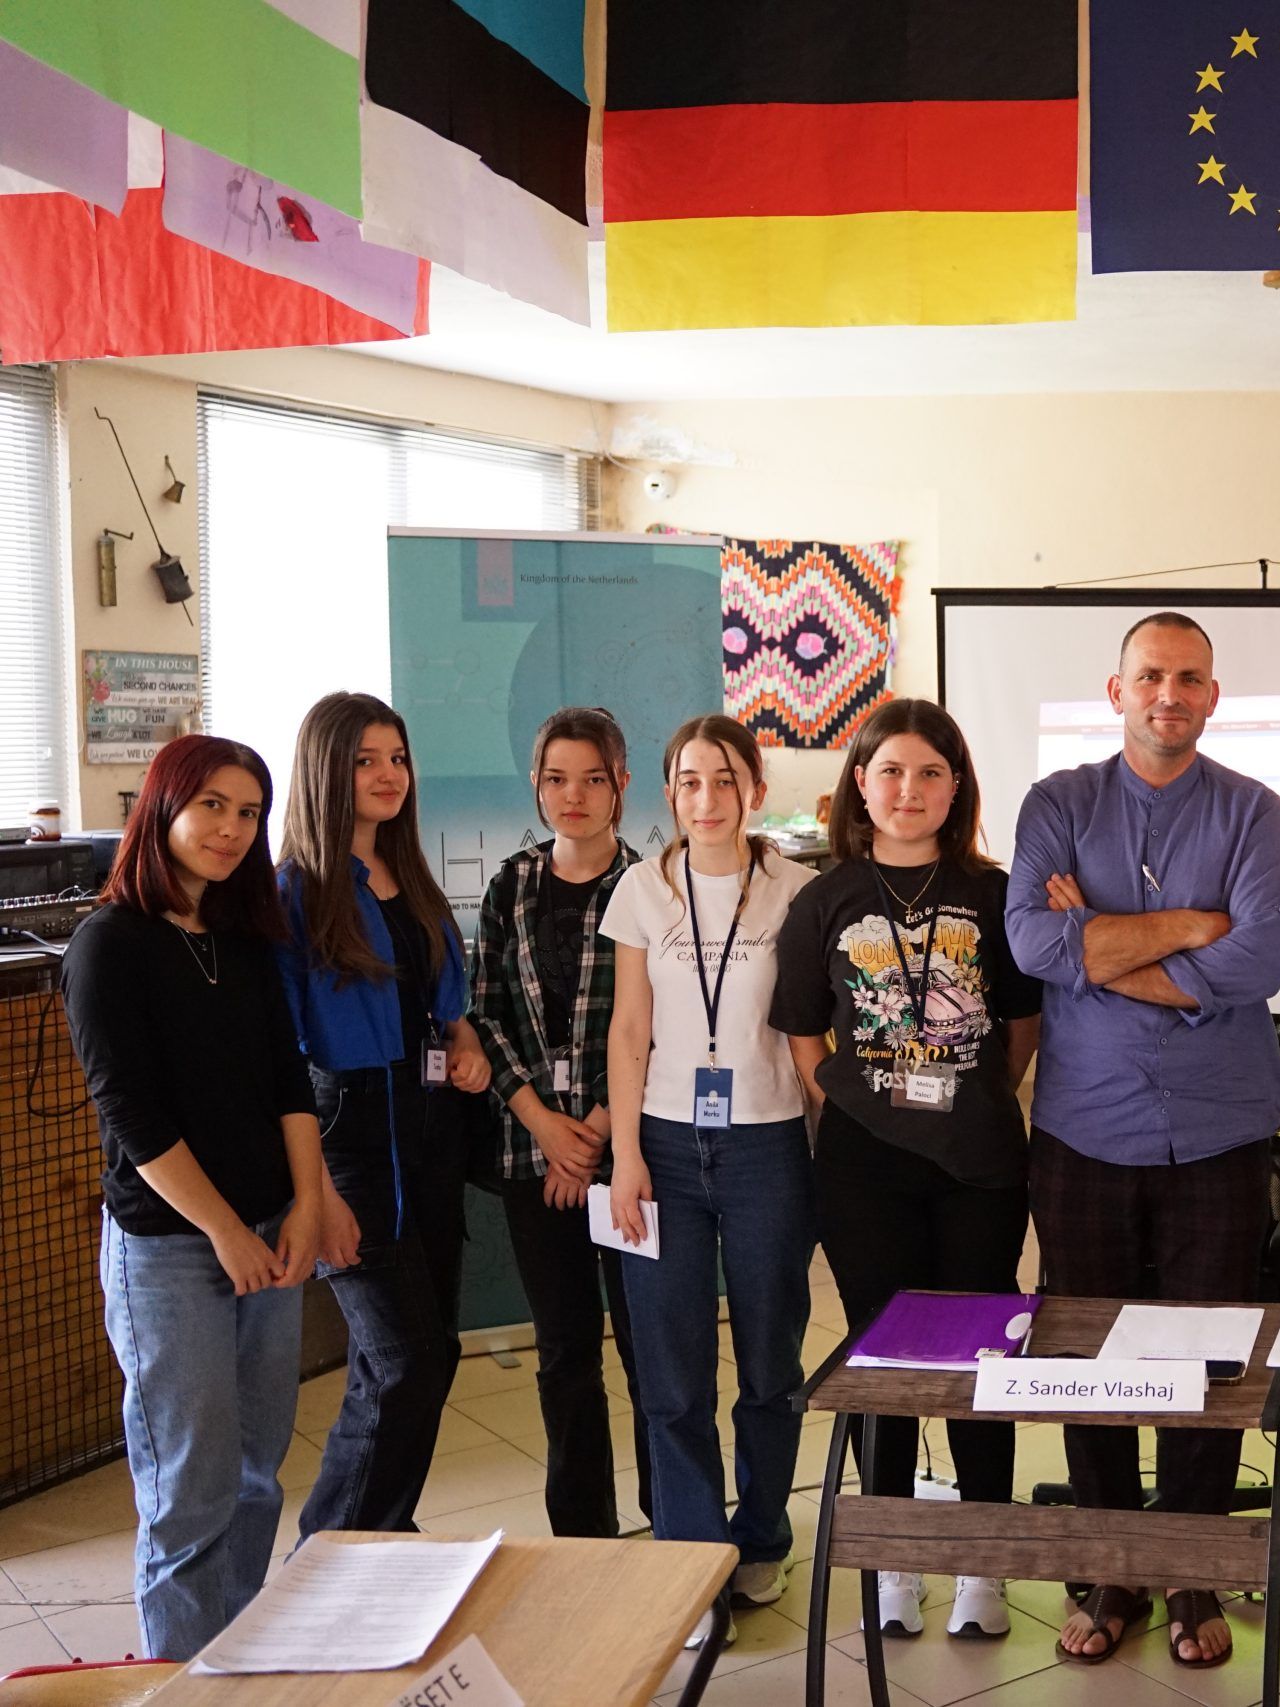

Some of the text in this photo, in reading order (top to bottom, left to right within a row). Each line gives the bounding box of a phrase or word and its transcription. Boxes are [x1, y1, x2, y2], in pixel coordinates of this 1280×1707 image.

[520, 574, 638, 585] Kingdom of the Netherlands
[115, 658, 193, 671] IN THIS HOUSE
[123, 681, 197, 691] SECOND CHANCES
[145, 714, 165, 723] FUN
[91, 731, 102, 739] WE
[127, 749, 140, 758] WE
[905, 911, 923, 924] Let's
[937, 904, 978, 917] Somewhere
[736, 929, 768, 947] smile
[857, 1045, 893, 1062] California
[1005, 1379, 1175, 1402] Z. Sander Vlashaj
